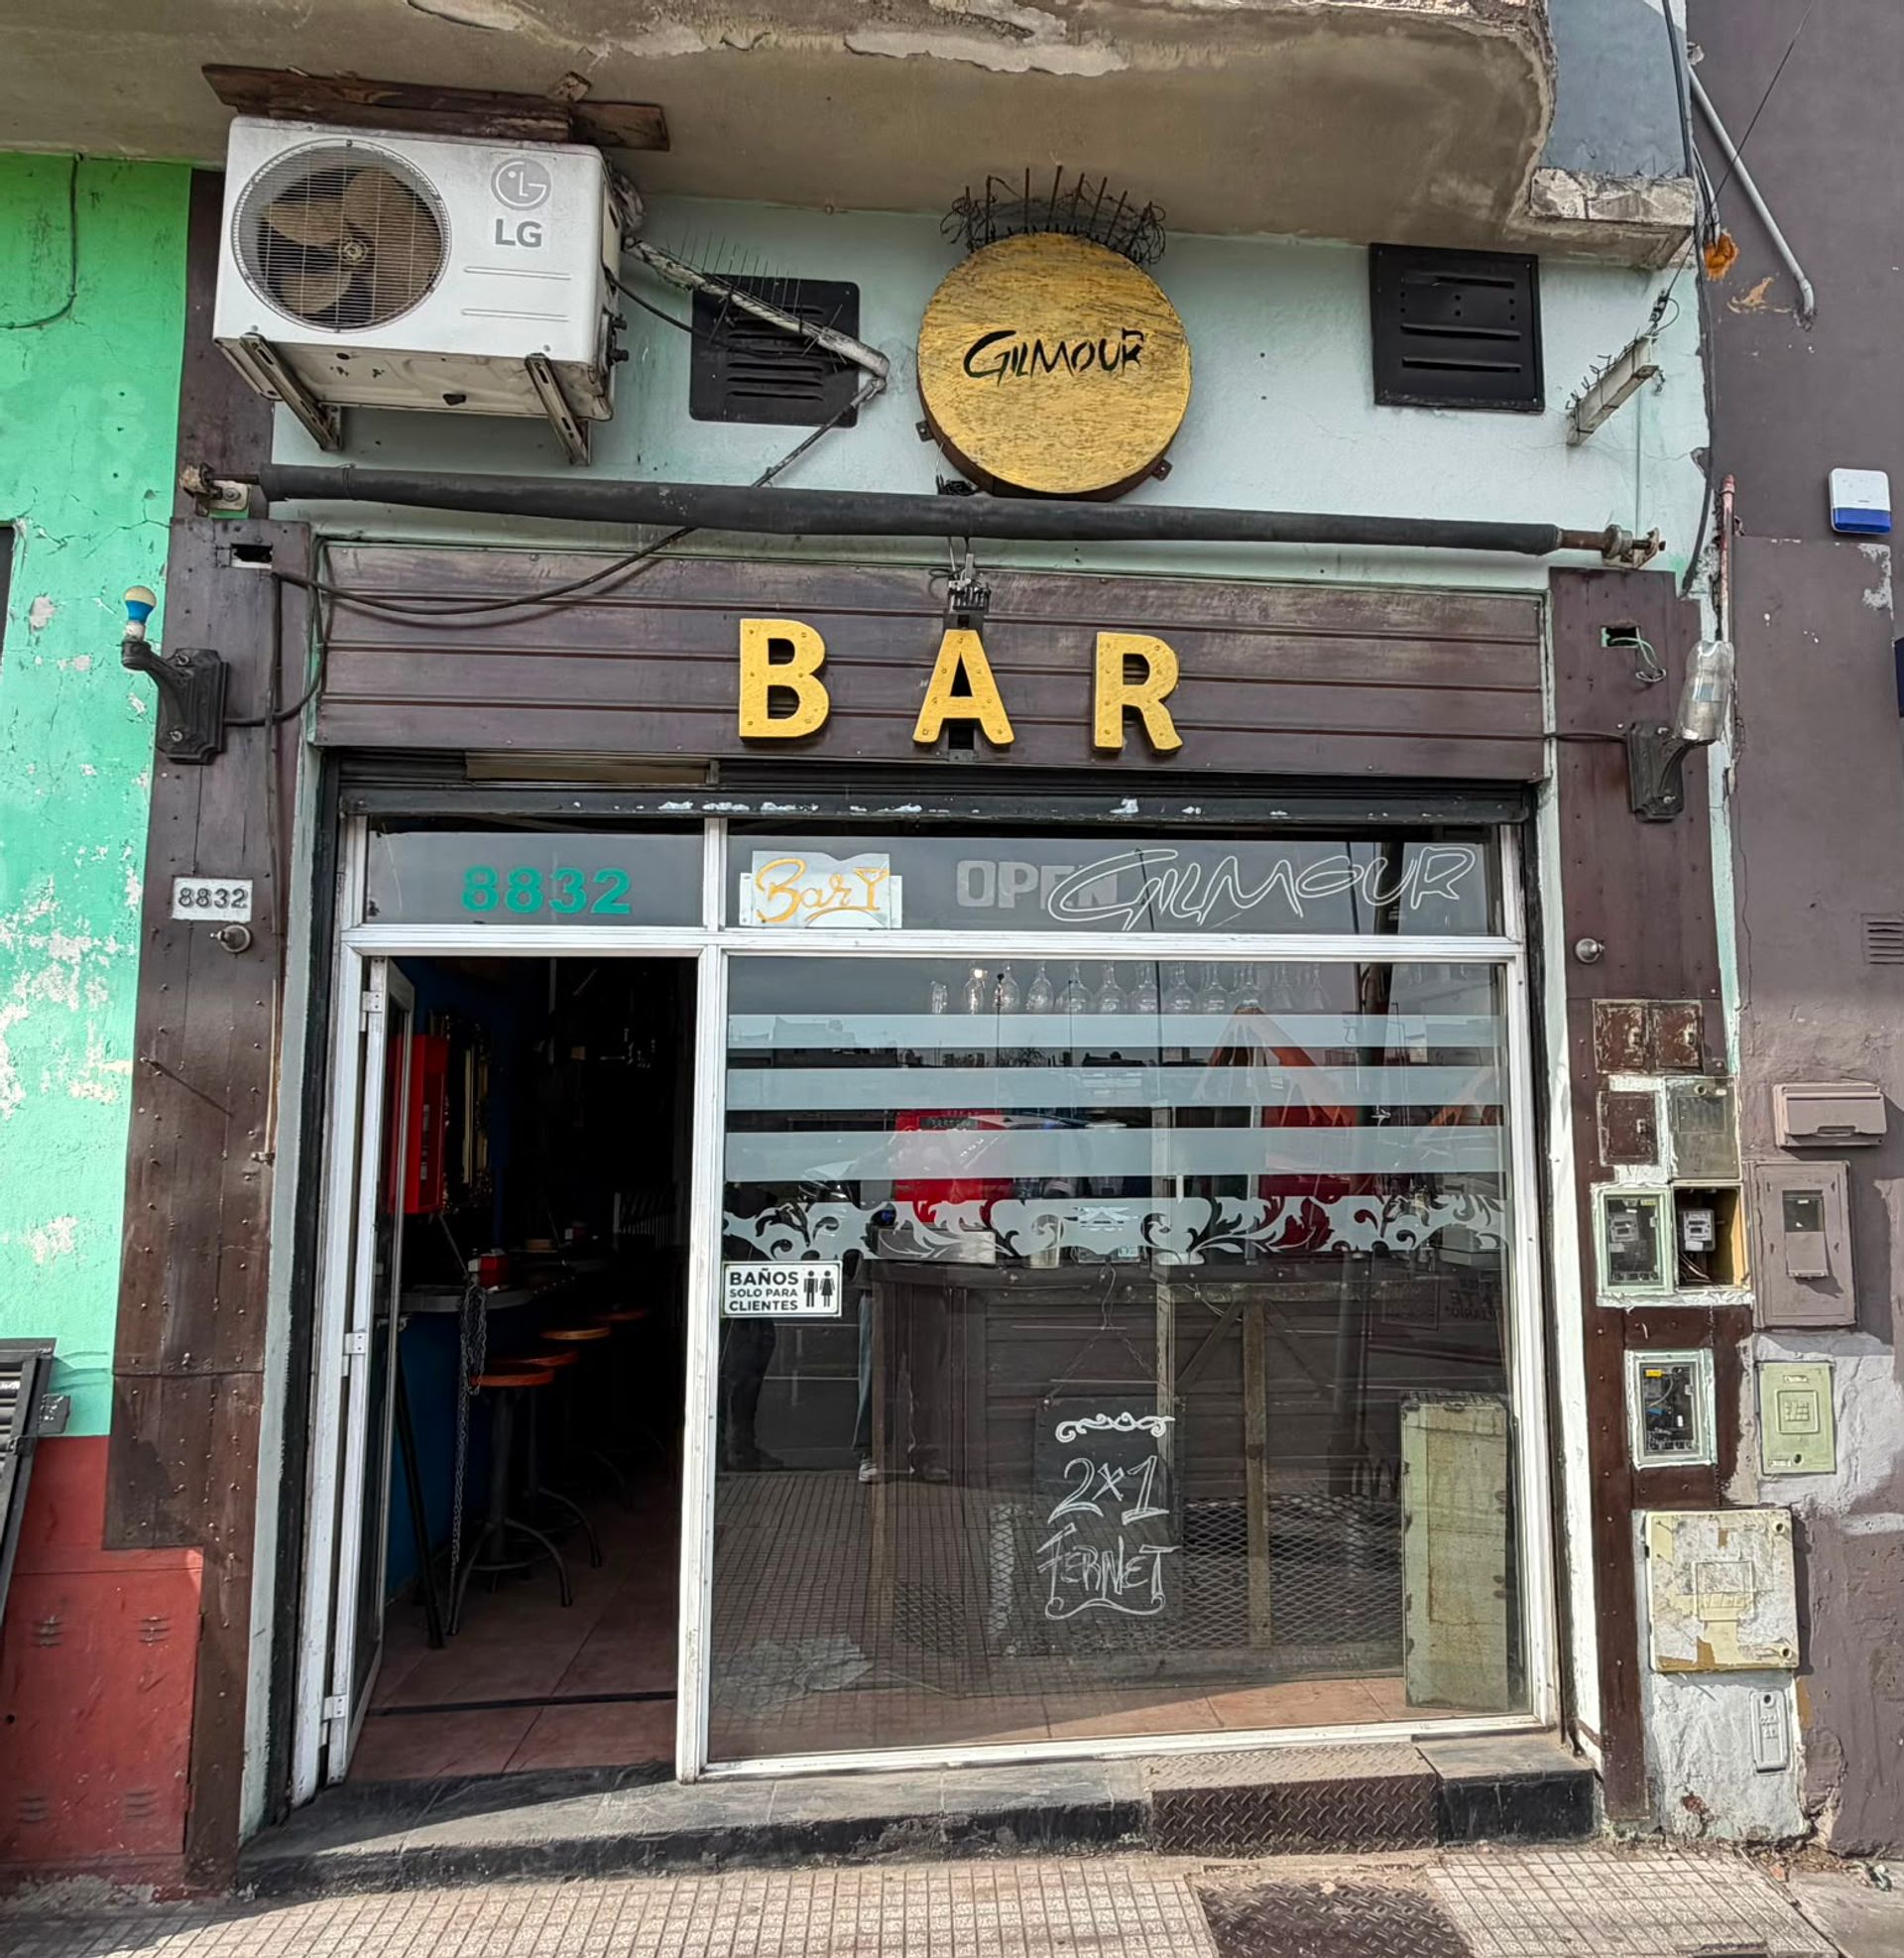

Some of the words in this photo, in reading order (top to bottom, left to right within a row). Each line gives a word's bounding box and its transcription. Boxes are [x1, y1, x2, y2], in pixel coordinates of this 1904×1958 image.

[495, 218, 543, 249] LG
[963, 327, 1145, 387] GILMOUR
[739, 618, 1184, 752] BAR
[178, 887, 250, 910] 8832
[459, 865, 633, 915] 8832
[1047, 848, 1477, 931] GILMOUR
[730, 1268, 799, 1285] BAÑOS
[729, 1299, 798, 1311] CLIENTES
[730, 1288, 763, 1298] SOLO
[766, 1288, 798, 1297] PARA
